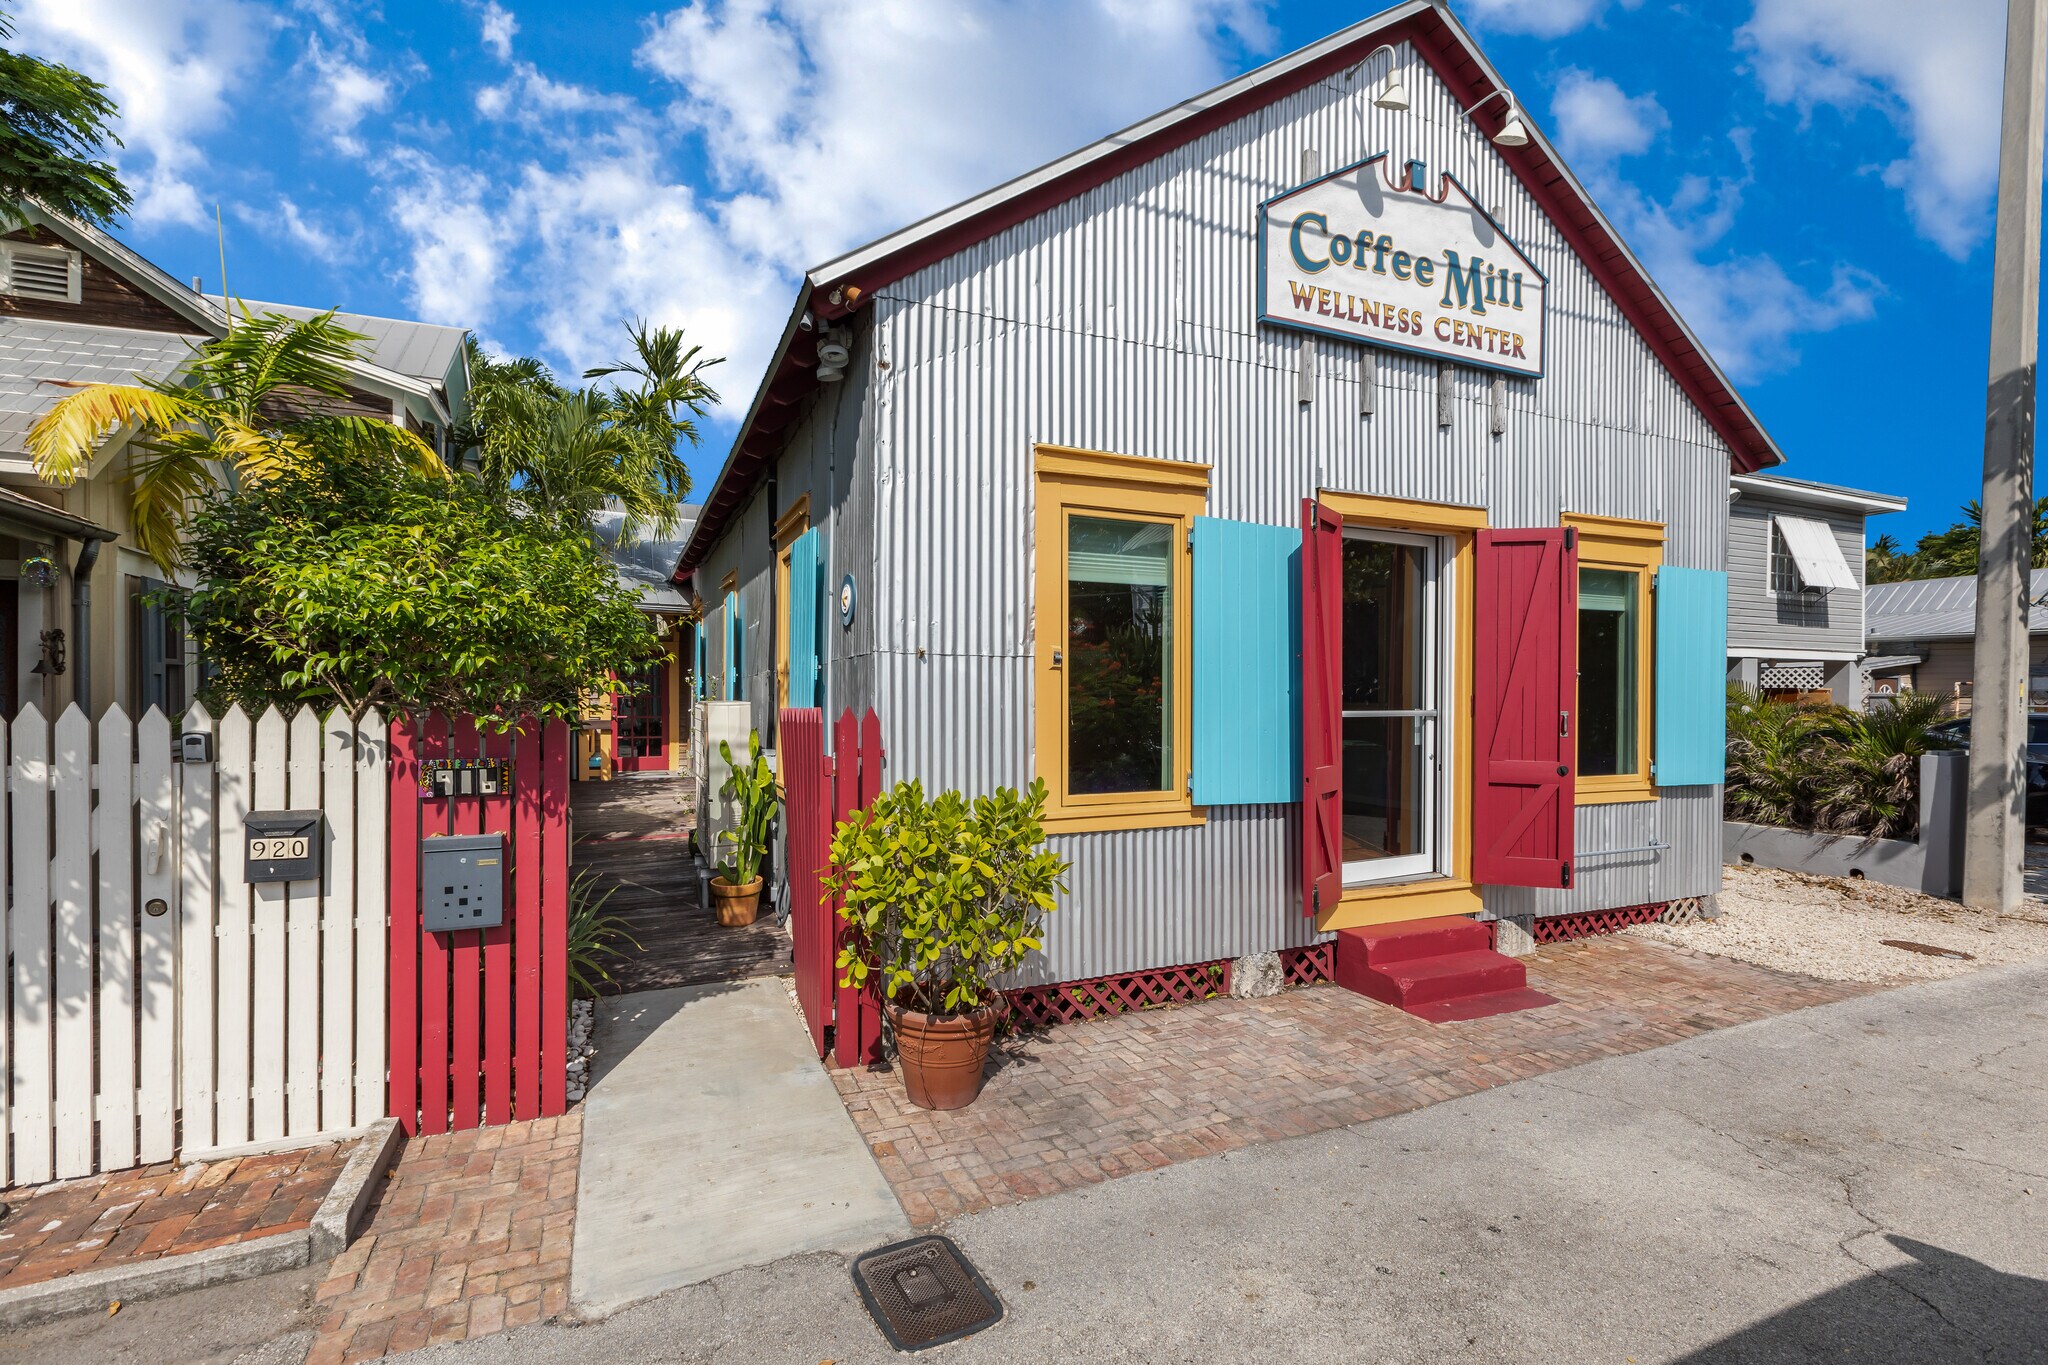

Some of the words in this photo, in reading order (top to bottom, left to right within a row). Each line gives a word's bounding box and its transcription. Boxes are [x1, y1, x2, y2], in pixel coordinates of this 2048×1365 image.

[1288, 211, 1434, 286] Coffee
[1439, 249, 1524, 316] Mill
[1288, 280, 1423, 336] WELLNESS
[1434, 316, 1526, 359] CENTER
[252, 840, 304, 858] 920
